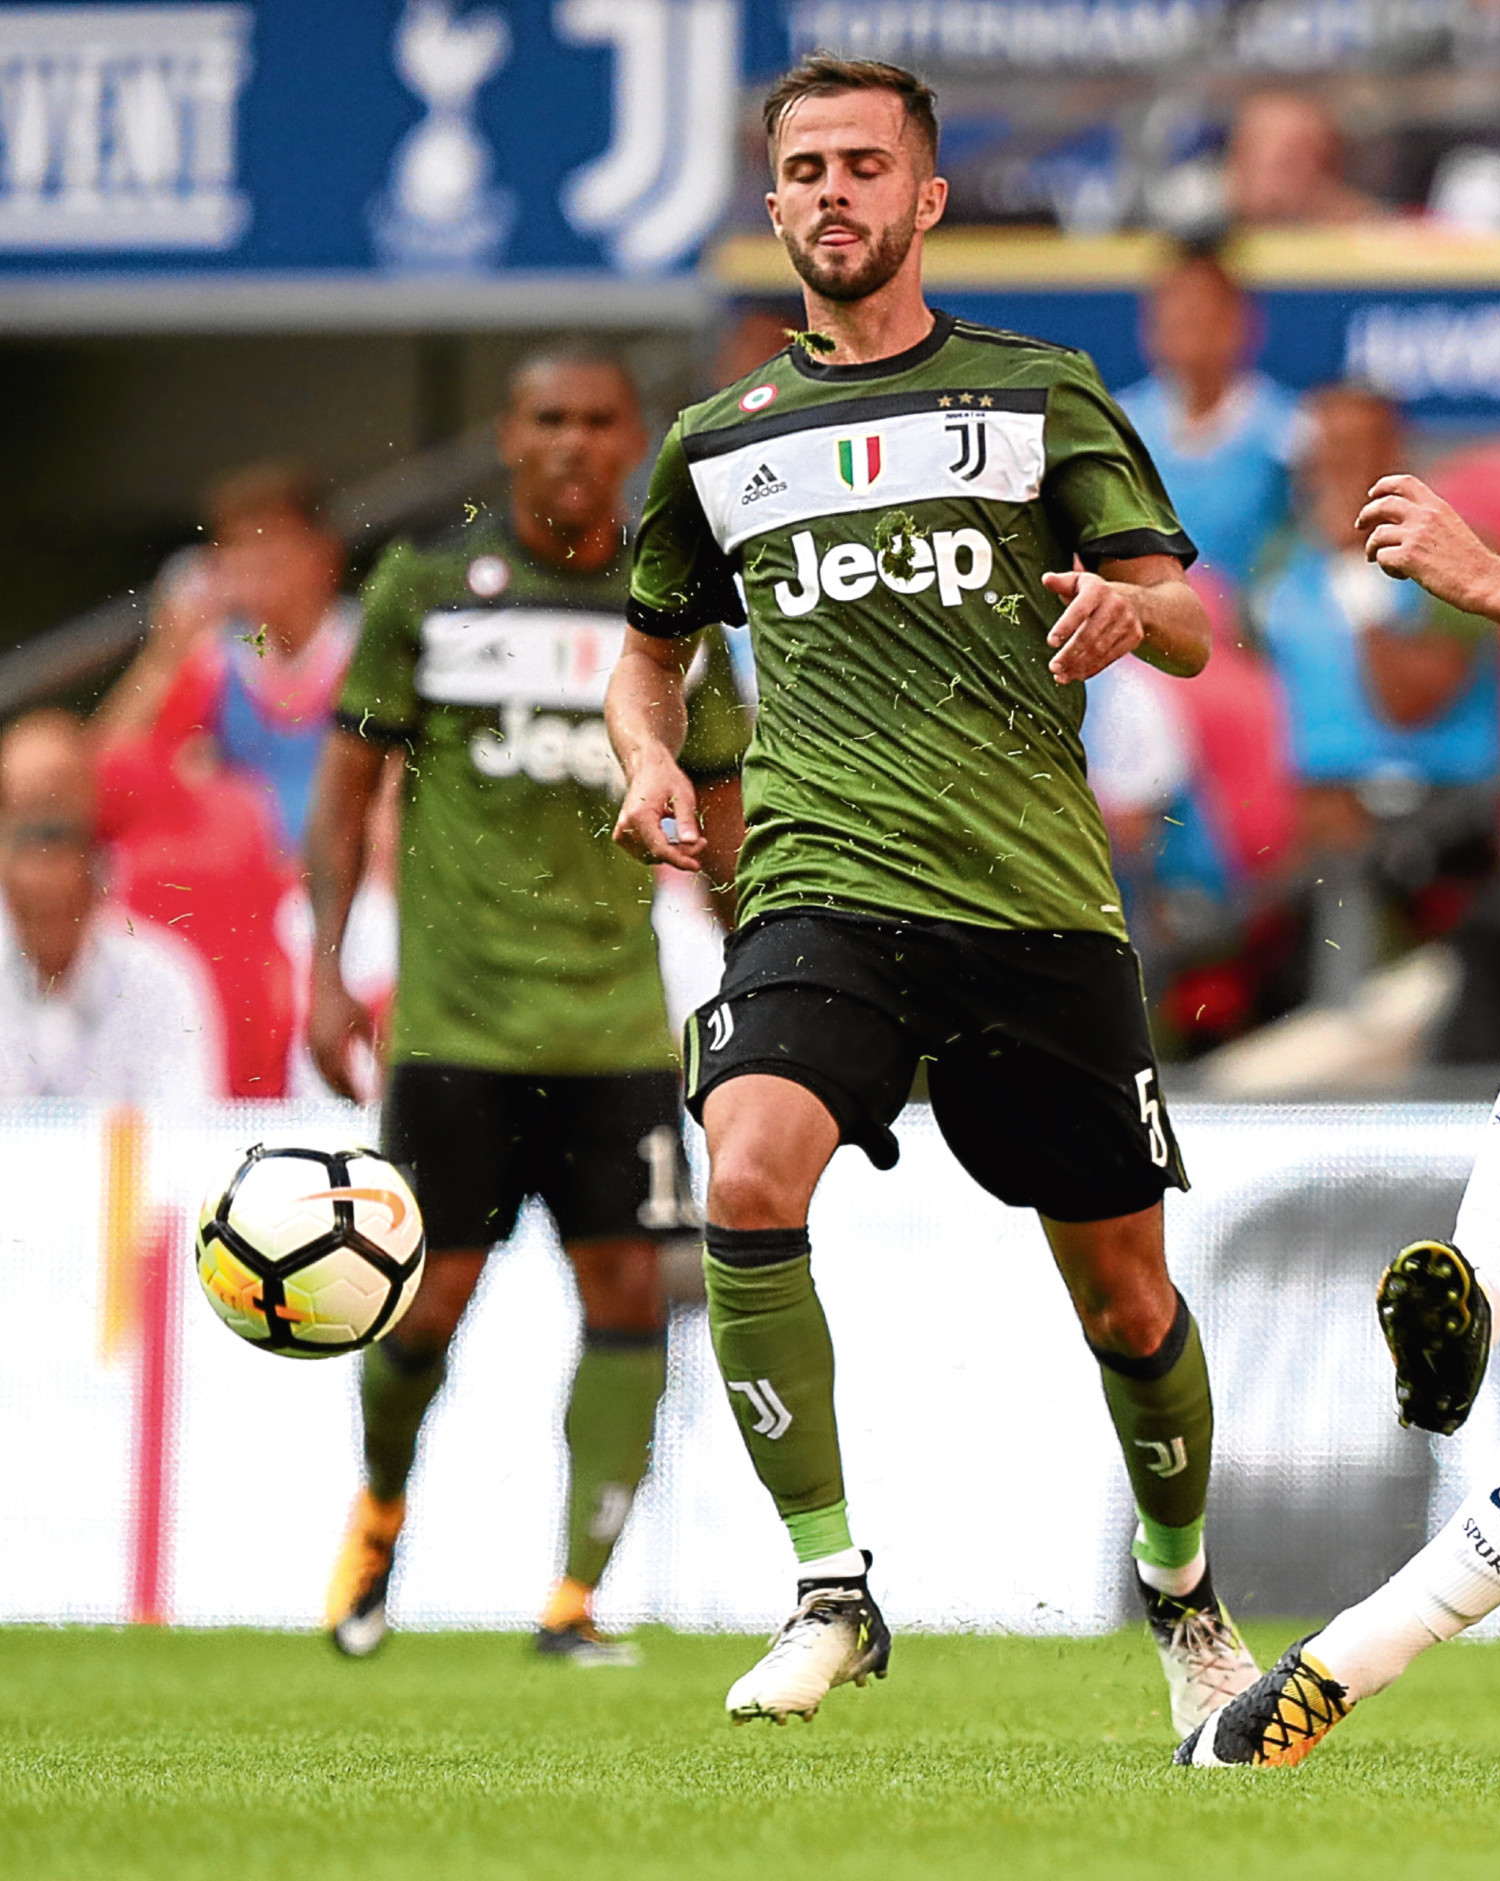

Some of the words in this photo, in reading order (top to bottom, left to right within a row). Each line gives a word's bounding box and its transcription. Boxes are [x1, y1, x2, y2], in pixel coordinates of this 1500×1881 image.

[741, 482, 788, 506] adidas
[774, 527, 993, 618] Jeep
[1134, 1067, 1168, 1168] 5
